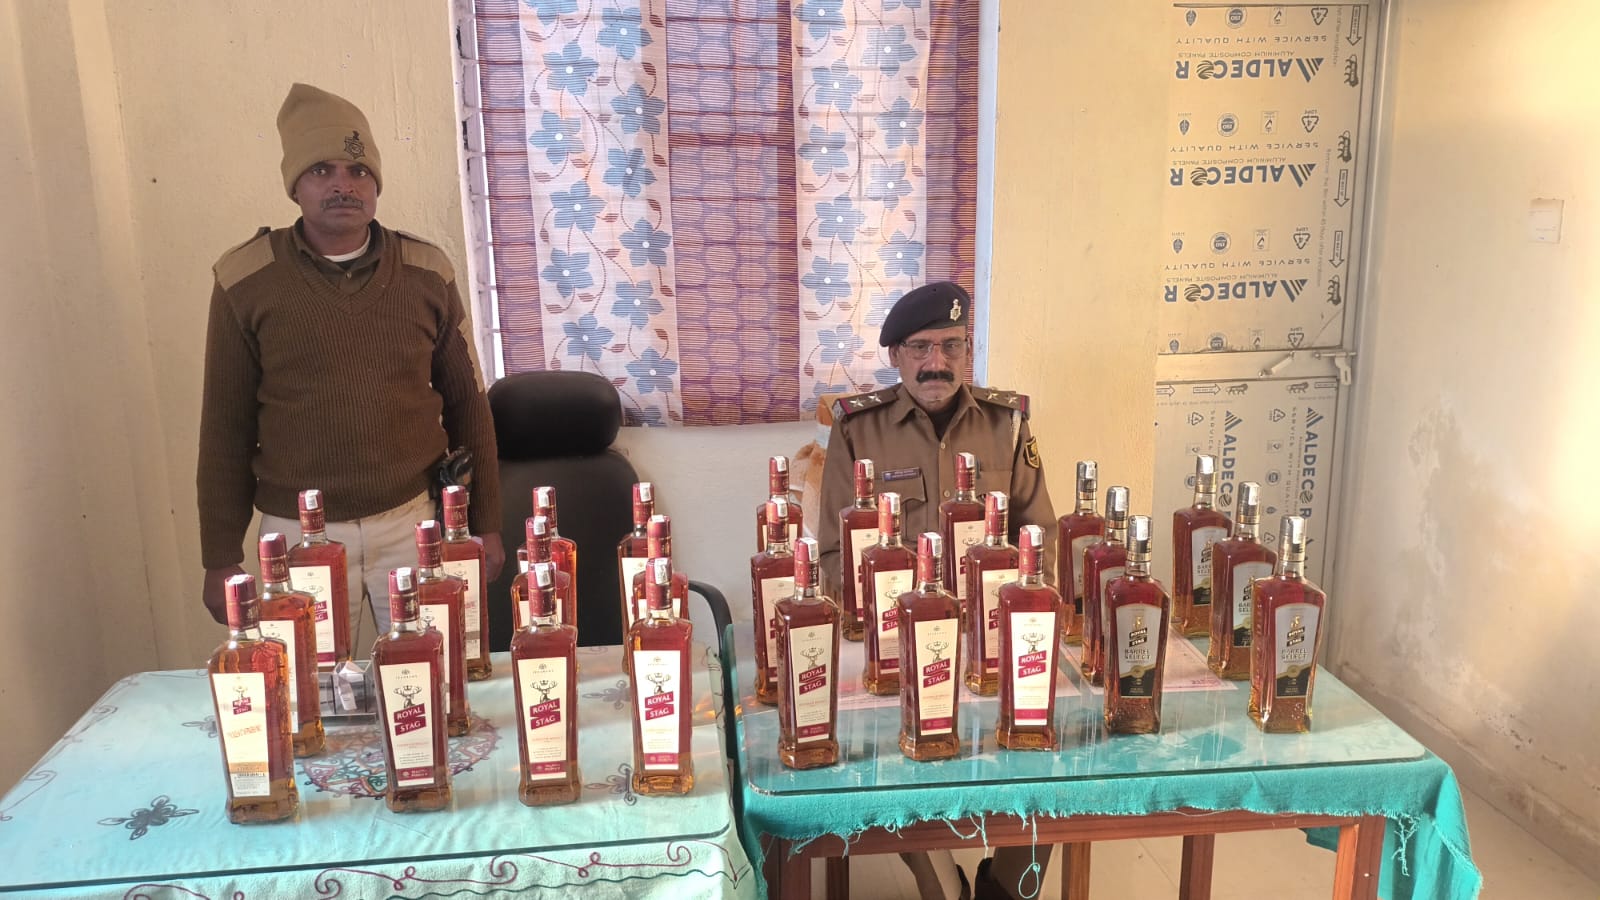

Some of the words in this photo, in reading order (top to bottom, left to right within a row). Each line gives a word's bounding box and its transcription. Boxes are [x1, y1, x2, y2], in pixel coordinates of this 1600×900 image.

[1164, 262, 1215, 270] QUALITY
[885, 610, 898, 618] ROY
[886, 621, 898, 629] STA
[1021, 653, 1043, 664] ROYAL
[925, 661, 947, 673] ROYAL
[1023, 665, 1041, 676] STAG
[801, 667, 824, 680] ROYAL
[927, 674, 946, 685] STAG
[803, 680, 822, 692] STAG
[647, 694, 671, 706] ROYAL
[397, 706, 422, 720] ROYAL
[532, 701, 557, 715] ROYAL
[650, 706, 669, 718] STAG
[400, 720, 421, 733] STAG
[535, 715, 556, 727] STAG
